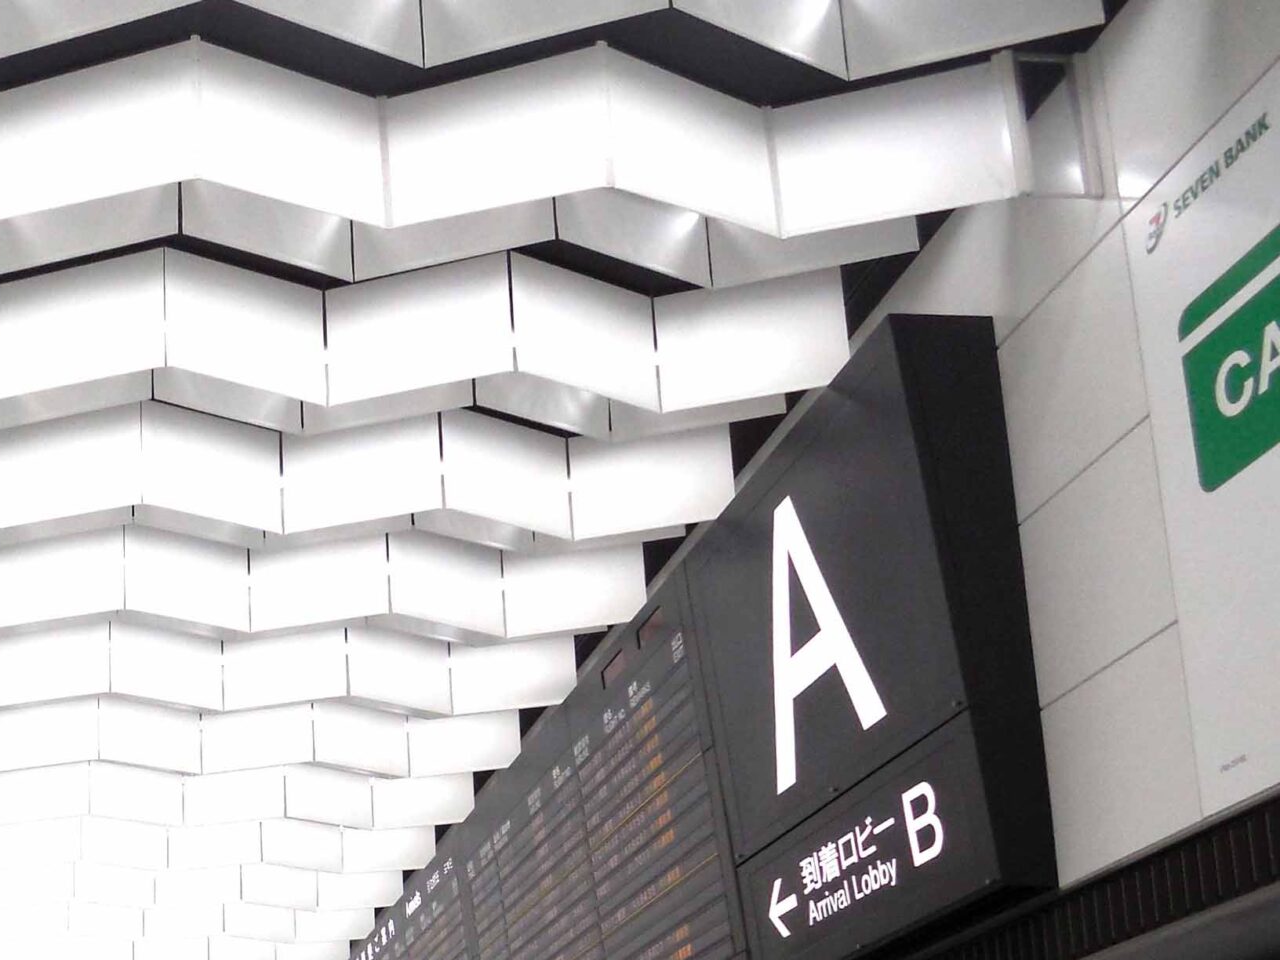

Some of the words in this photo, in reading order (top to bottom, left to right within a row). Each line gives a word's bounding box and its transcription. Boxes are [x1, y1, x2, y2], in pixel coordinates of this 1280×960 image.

[1173, 160, 1220, 218] SEVEN
[1223, 112, 1270, 169] BANK
[772, 495, 887, 795] A
[799, 815, 896, 895] 到着ロビー
[901, 781, 944, 868] B
[808, 879, 851, 926] Arrival
[851, 857, 897, 900] Lobby
